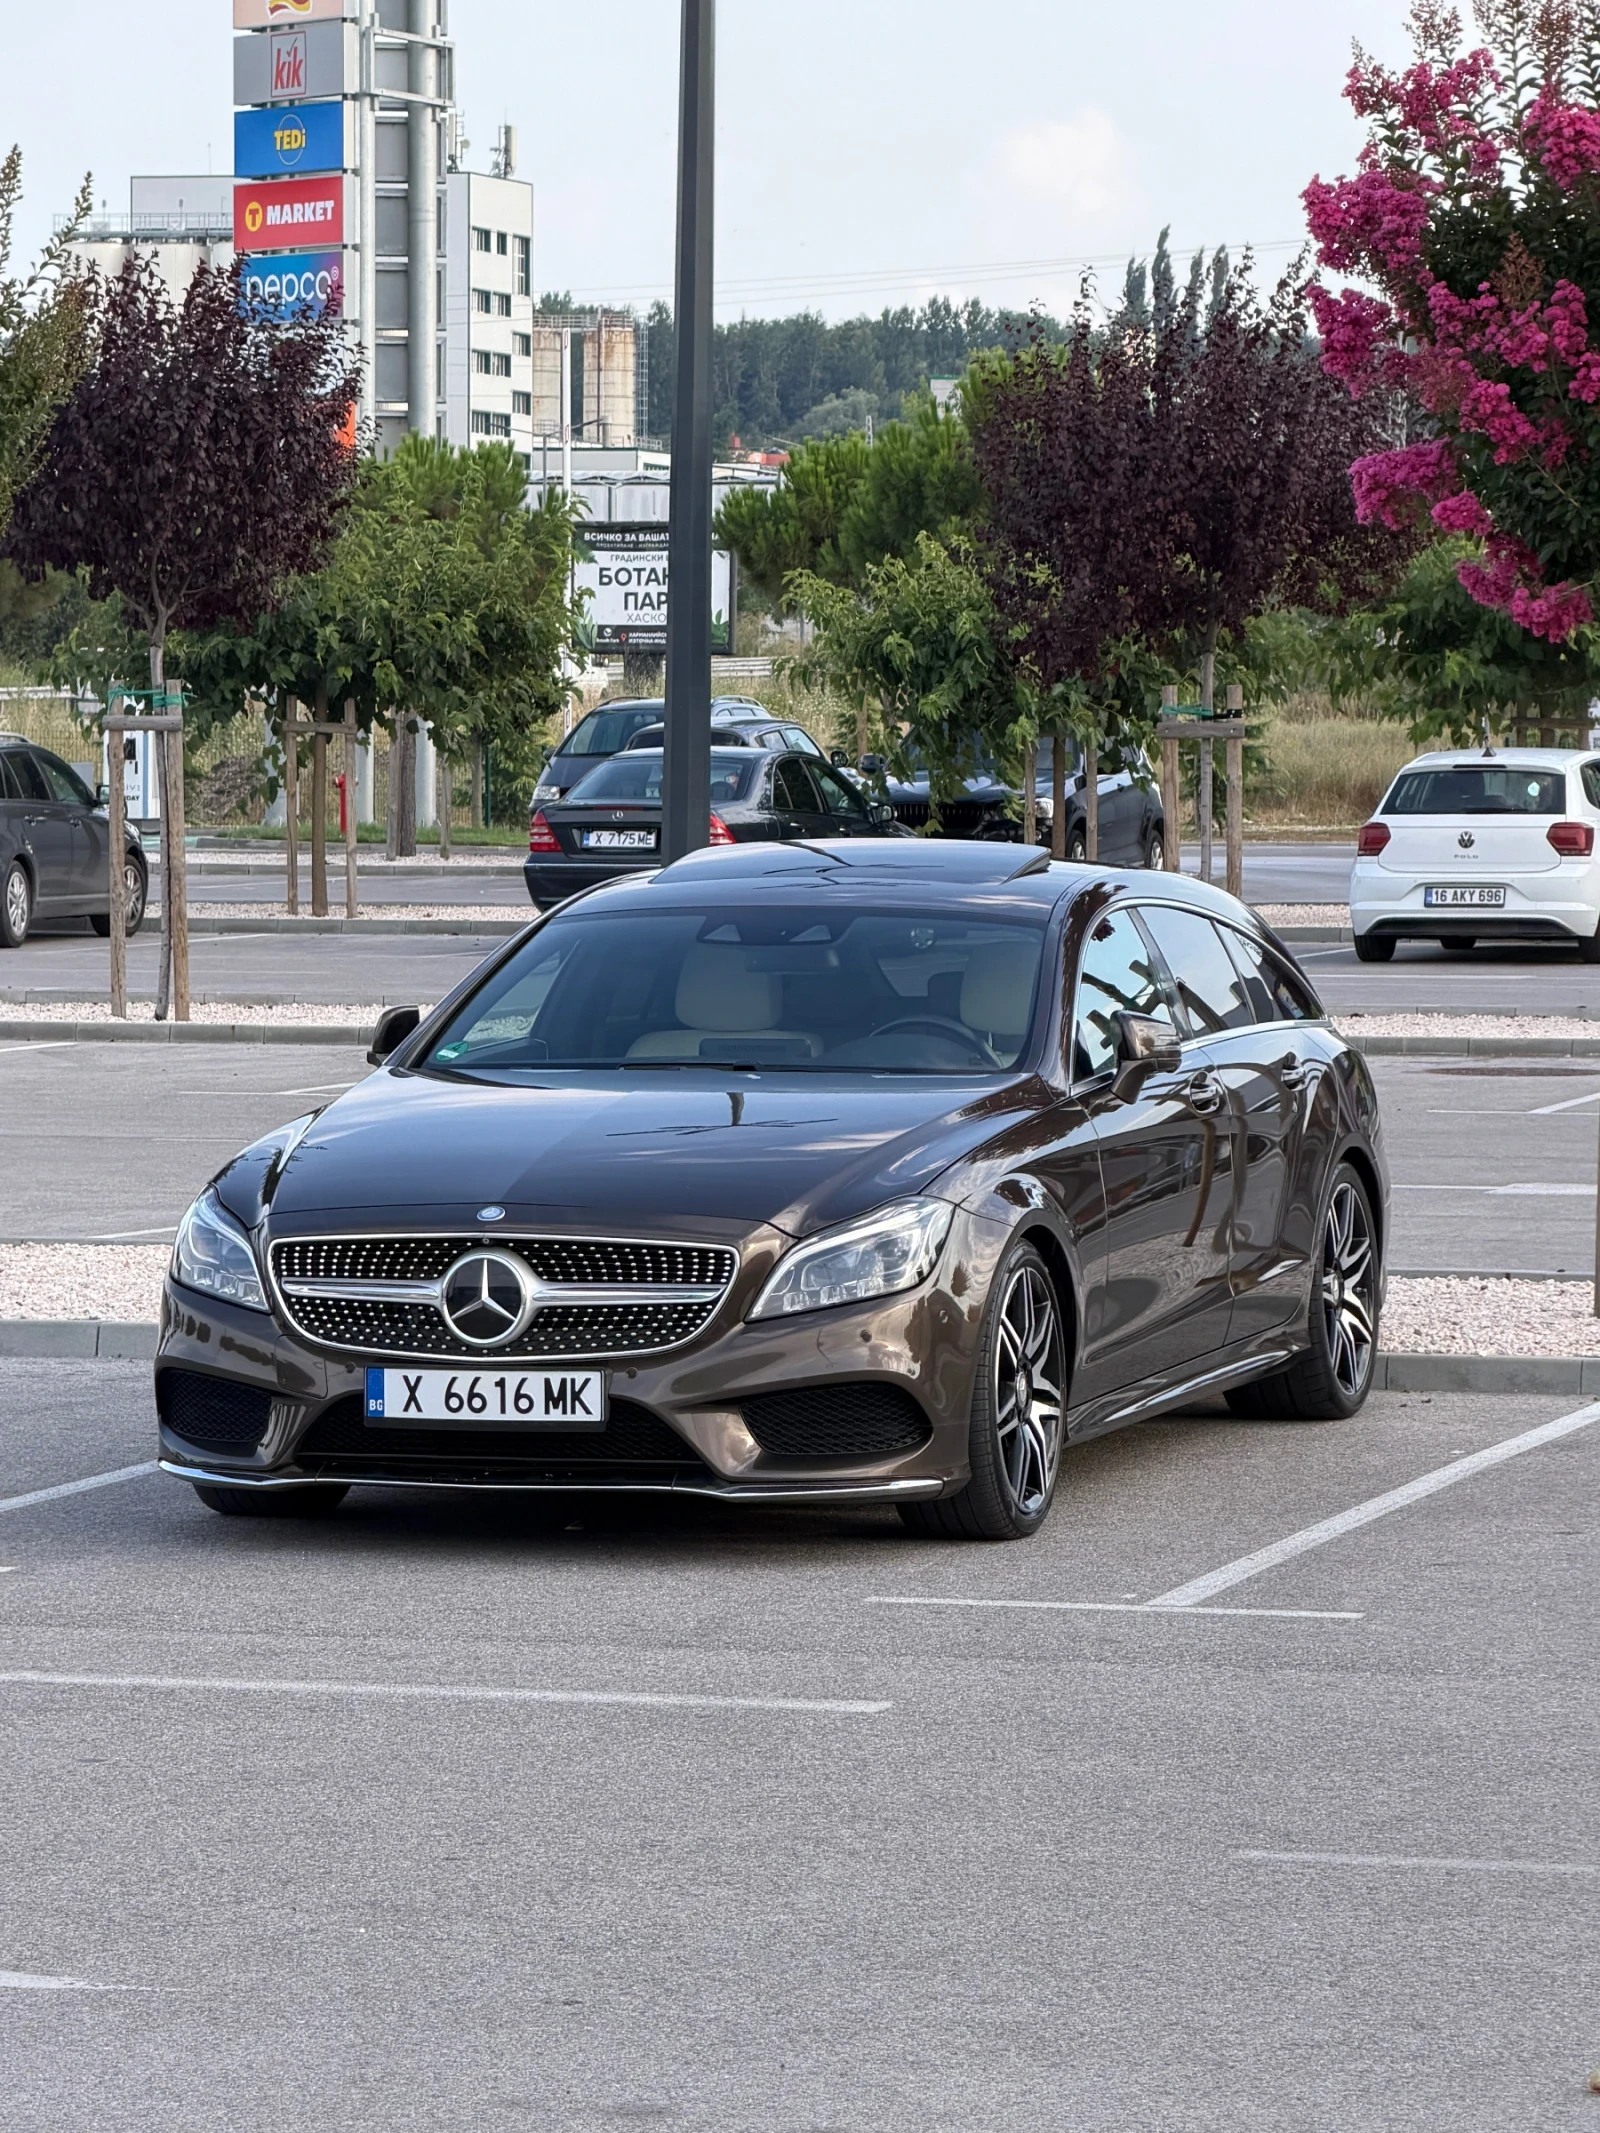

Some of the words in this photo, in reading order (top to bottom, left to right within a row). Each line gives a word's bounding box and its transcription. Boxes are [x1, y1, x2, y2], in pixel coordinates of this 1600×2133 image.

[273, 128, 307, 151] TEDi
[265, 200, 335, 226] MARKET
[584, 532, 622, 541] ВСИЧКО
[624, 533, 636, 541] ЗА
[610, 554, 663, 562] ГРАДИНСКИ
[626, 613, 667, 623] ХАСКО
[595, 833, 603, 845] X
[1434, 889, 1447, 902] 16
[1451, 889, 1476, 902] AKY
[1478, 889, 1502, 902] 696
[402, 1375, 424, 1413] X
[444, 1376, 535, 1415] 6616
[543, 1376, 593, 1416] MK
[369, 1399, 384, 1411] BG
